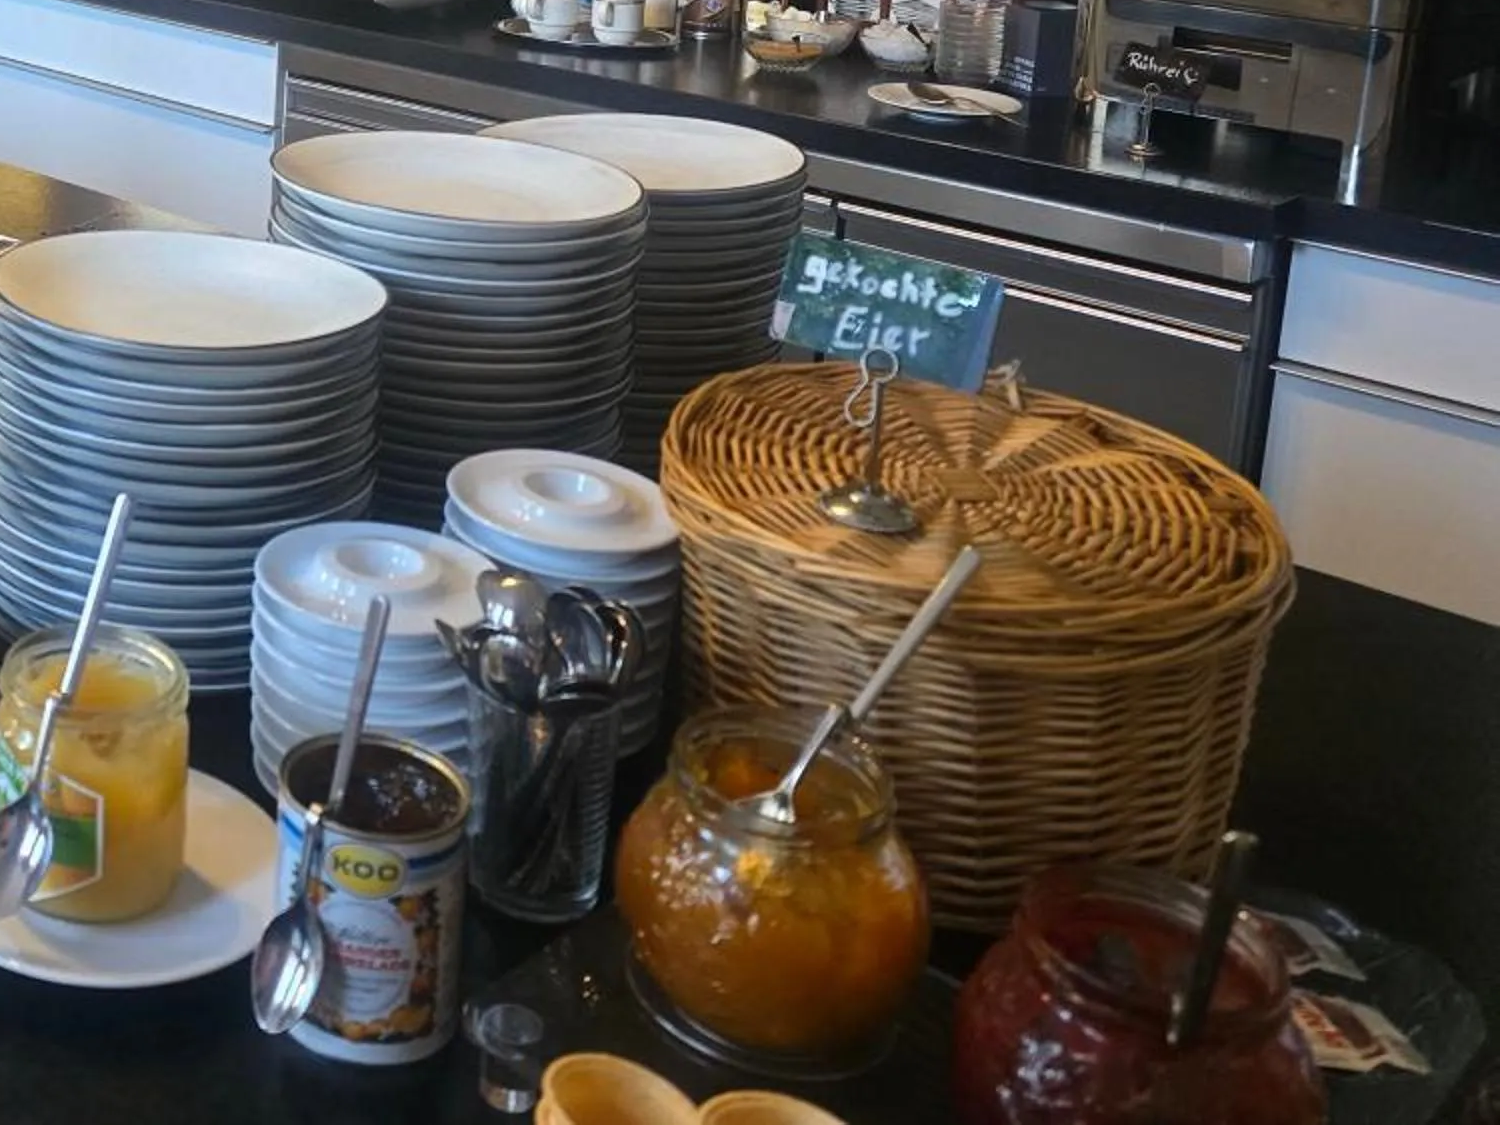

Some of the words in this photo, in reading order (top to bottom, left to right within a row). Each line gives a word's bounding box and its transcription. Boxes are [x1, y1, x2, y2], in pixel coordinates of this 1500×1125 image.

[796, 254, 964, 318] gekochte
[831, 304, 931, 357] Eier
[331, 854, 400, 882] KOO
